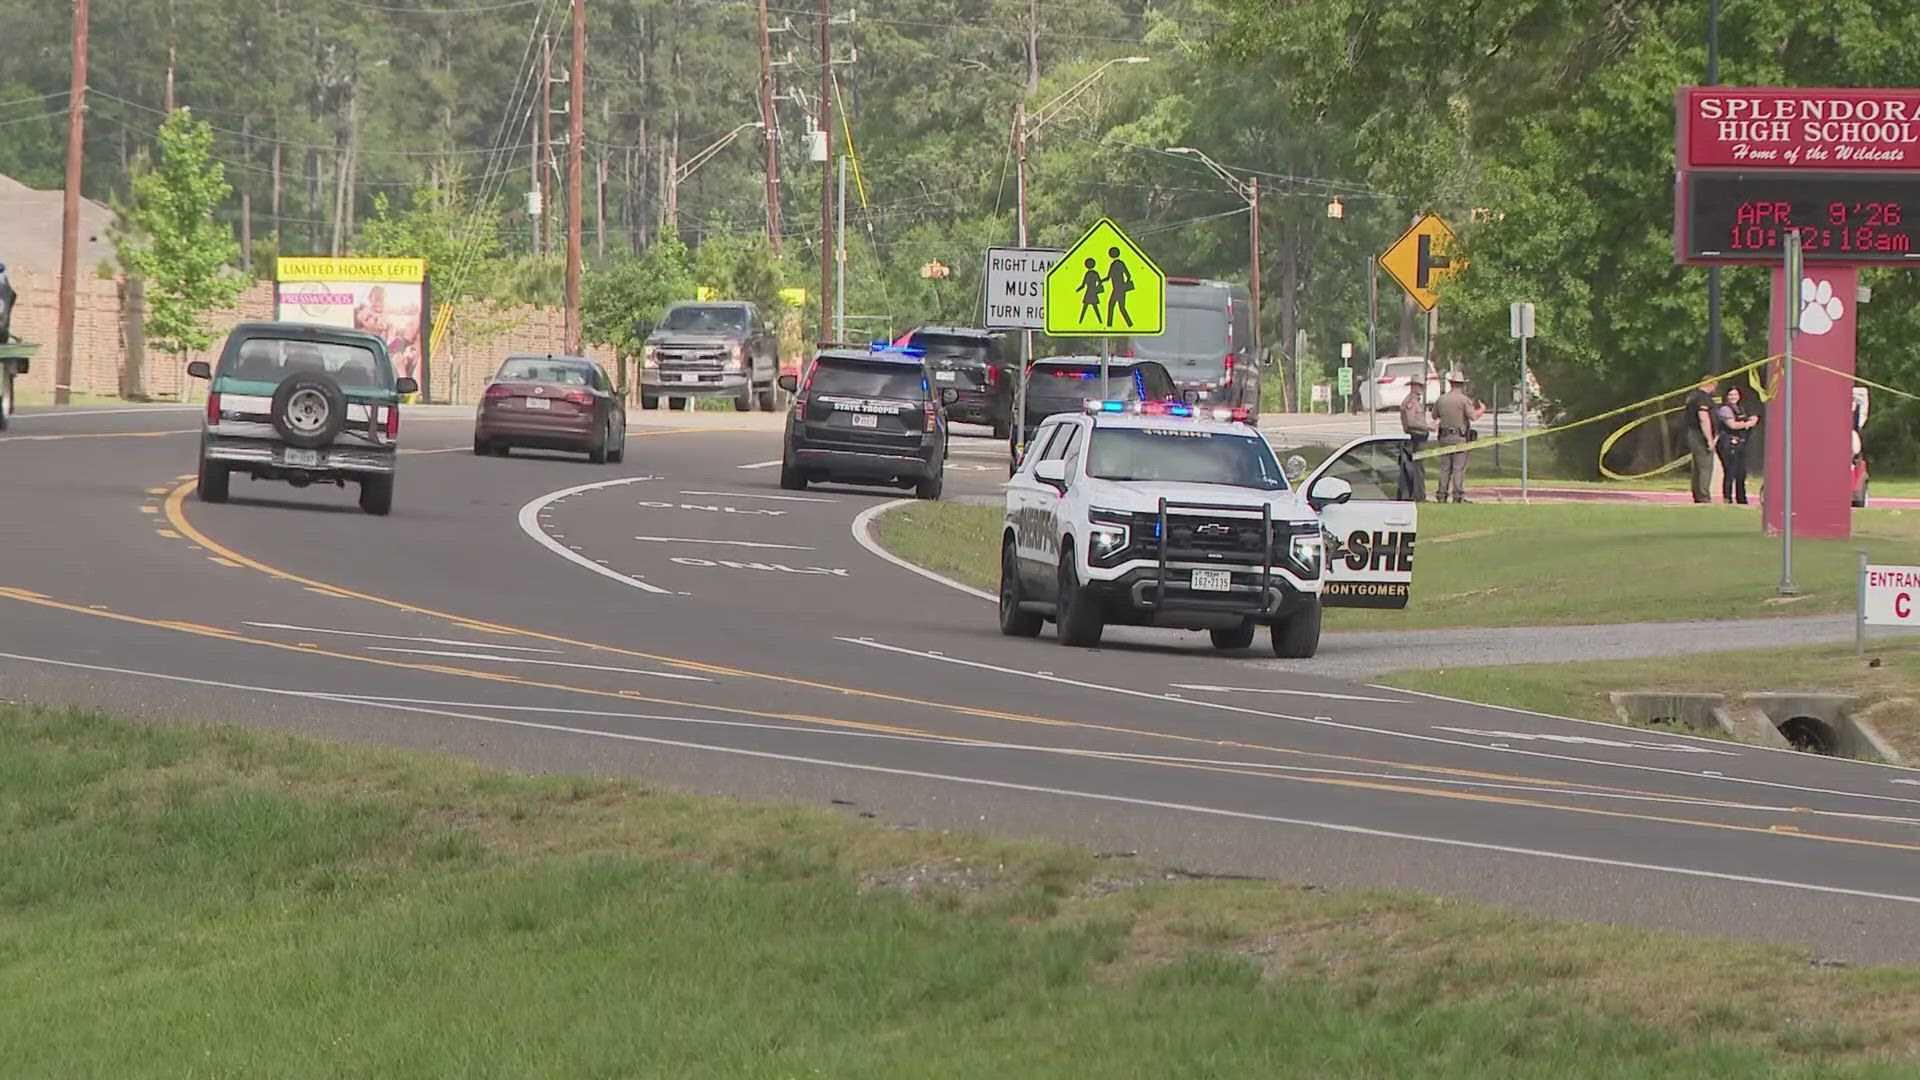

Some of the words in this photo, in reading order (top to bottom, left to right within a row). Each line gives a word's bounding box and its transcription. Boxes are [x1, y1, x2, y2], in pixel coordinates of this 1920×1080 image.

[1717, 120, 1791, 141] HIGH
[1803, 121, 1918, 143] SCHOOL
[1732, 143, 1777, 160] Home
[1783, 146, 1801, 164] of
[1805, 145, 1828, 160] the
[1834, 144, 1904, 161] Wildcats
[1736, 202, 1792, 225] APR
[1731, 226, 1909, 251] 10:2:18am
[283, 263, 334, 275] LIMITED
[339, 263, 383, 276] HOMES
[388, 264, 418, 276] LEFT!
[992, 258, 1027, 272] RIGHT
[1031, 259, 1057, 272] LAN
[990, 304, 1020, 318] TURN
[834, 402, 860, 412] STATE
[862, 404, 899, 415] TROOPER
[638, 501, 788, 516] ONLY
[669, 557, 850, 577] ONLY
[1895, 592, 1911, 618] C
